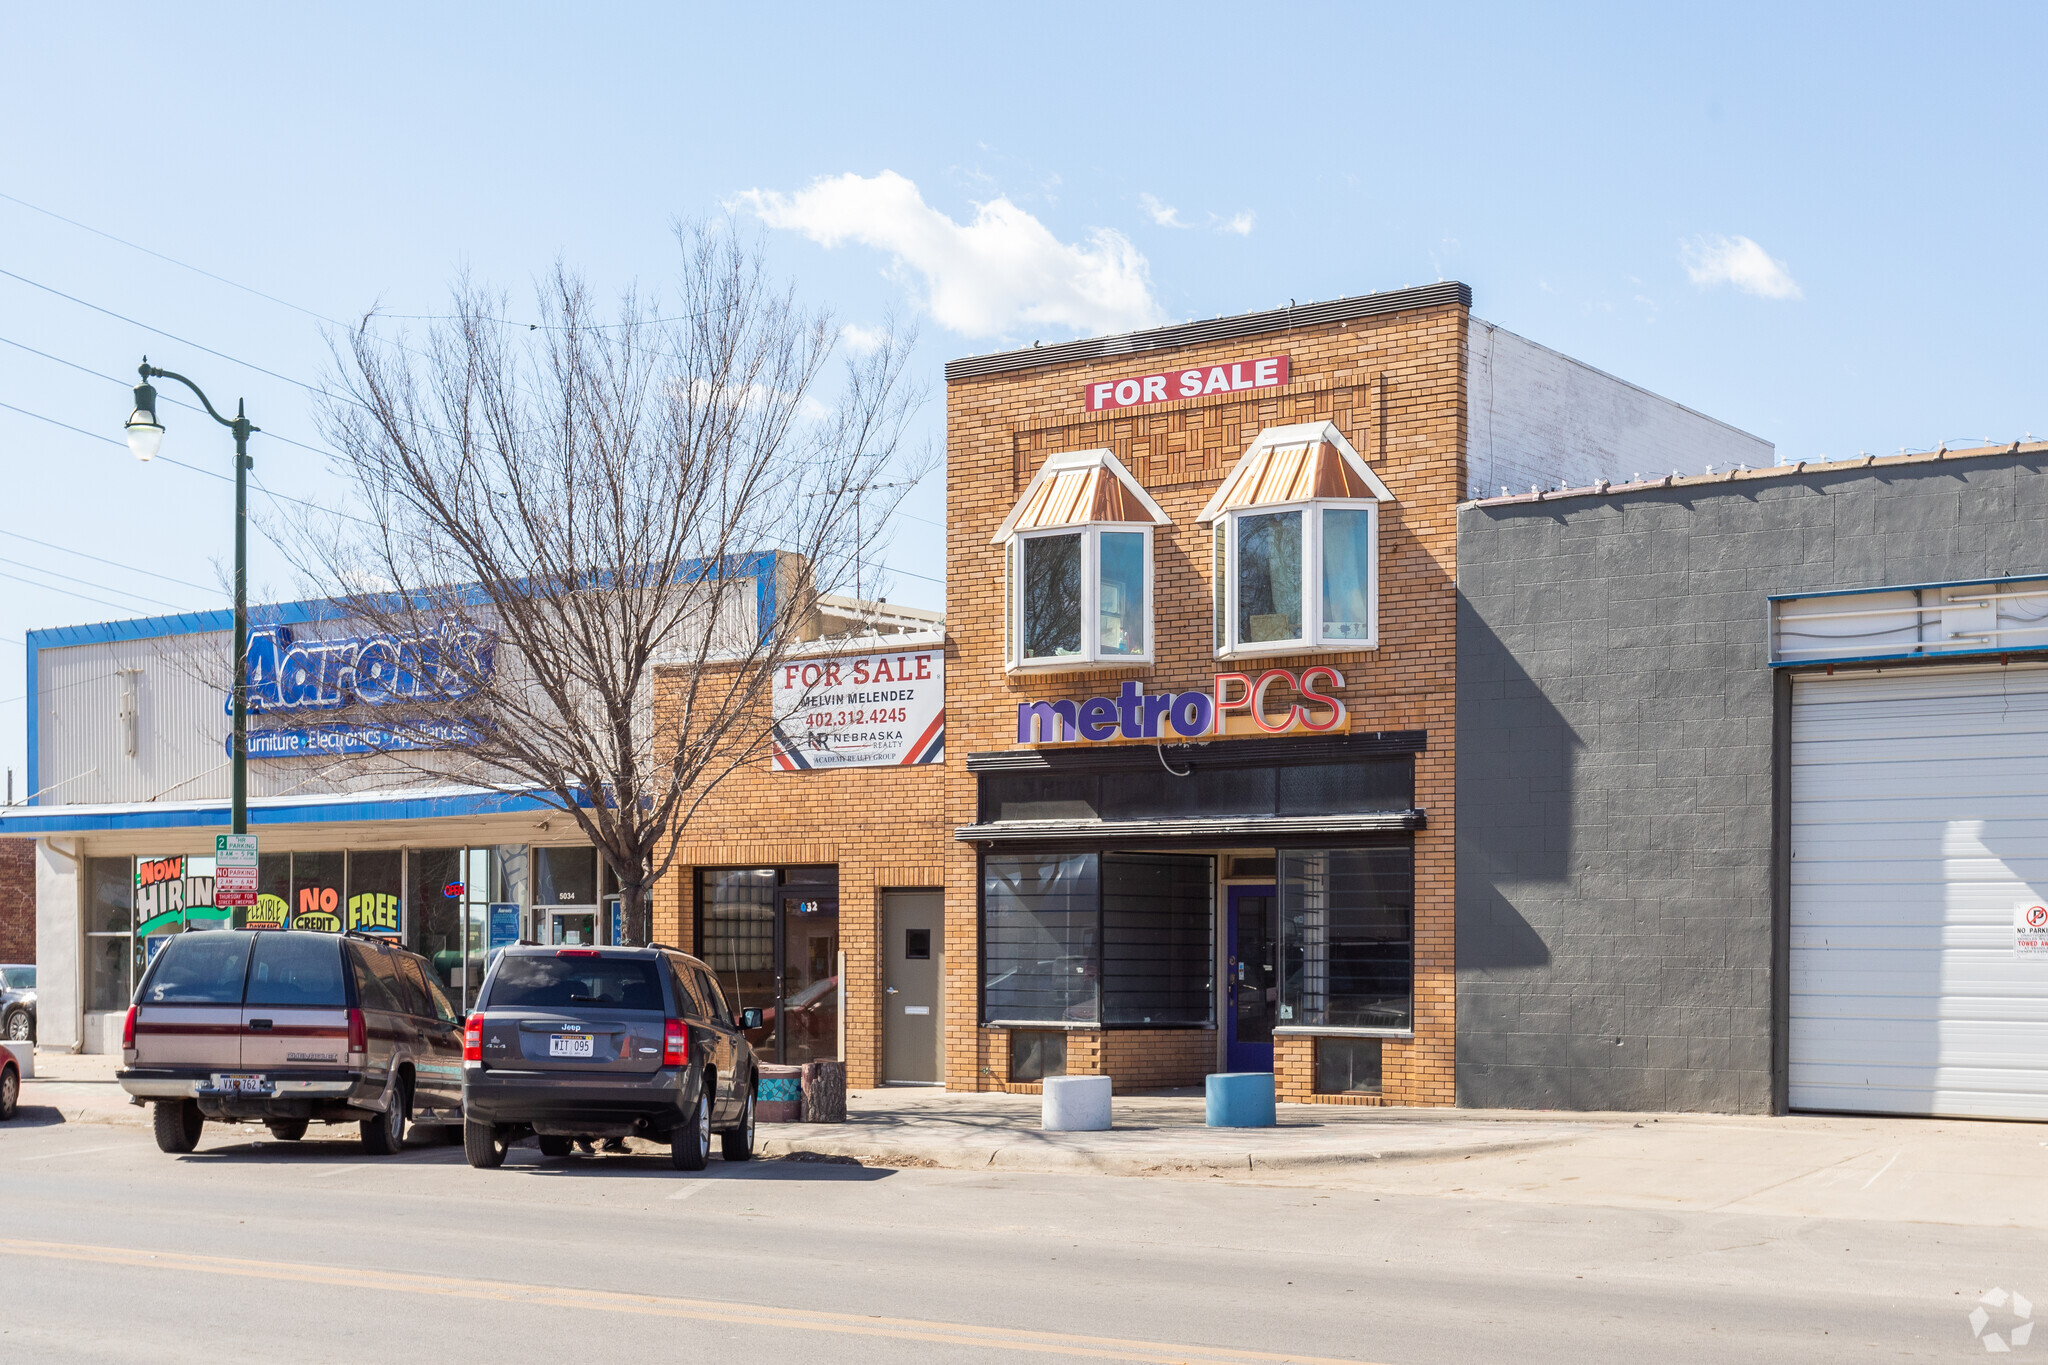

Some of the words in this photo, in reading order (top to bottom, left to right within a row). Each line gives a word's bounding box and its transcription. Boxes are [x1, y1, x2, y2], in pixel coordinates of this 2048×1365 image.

[1094, 375, 1168, 410] FOR
[1179, 358, 1278, 397] SALE
[784, 661, 842, 690] FOR
[853, 654, 931, 685] SALE
[800, 694, 844, 707] MELVIN
[848, 689, 914, 704] MELENDEZ
[1017, 666, 1346, 744] metroPCS
[805, 707, 907, 728] 402.312.4245
[246, 733, 299, 753] urniture
[308, 729, 381, 750] Electronics
[391, 723, 468, 747] Appliances
[833, 730, 903, 743] NEBRASKA
[873, 741, 904, 749] REALTY
[873, 753, 896, 761] GROUP
[218, 837, 225, 848] 2
[140, 857, 182, 886] NOW
[217, 868, 228, 877] NO
[444, 885, 464, 896] OPEN
[559, 892, 575, 900] 5034
[300, 887, 339, 914] NO
[348, 892, 398, 931] FREE
[296, 917, 334, 930] CREDIT
[561, 1023, 581, 1033] Jeep
[554, 1040, 569, 1051] WIT
[574, 1040, 589, 1051] 095
[242, 1079, 257, 1090] 762
